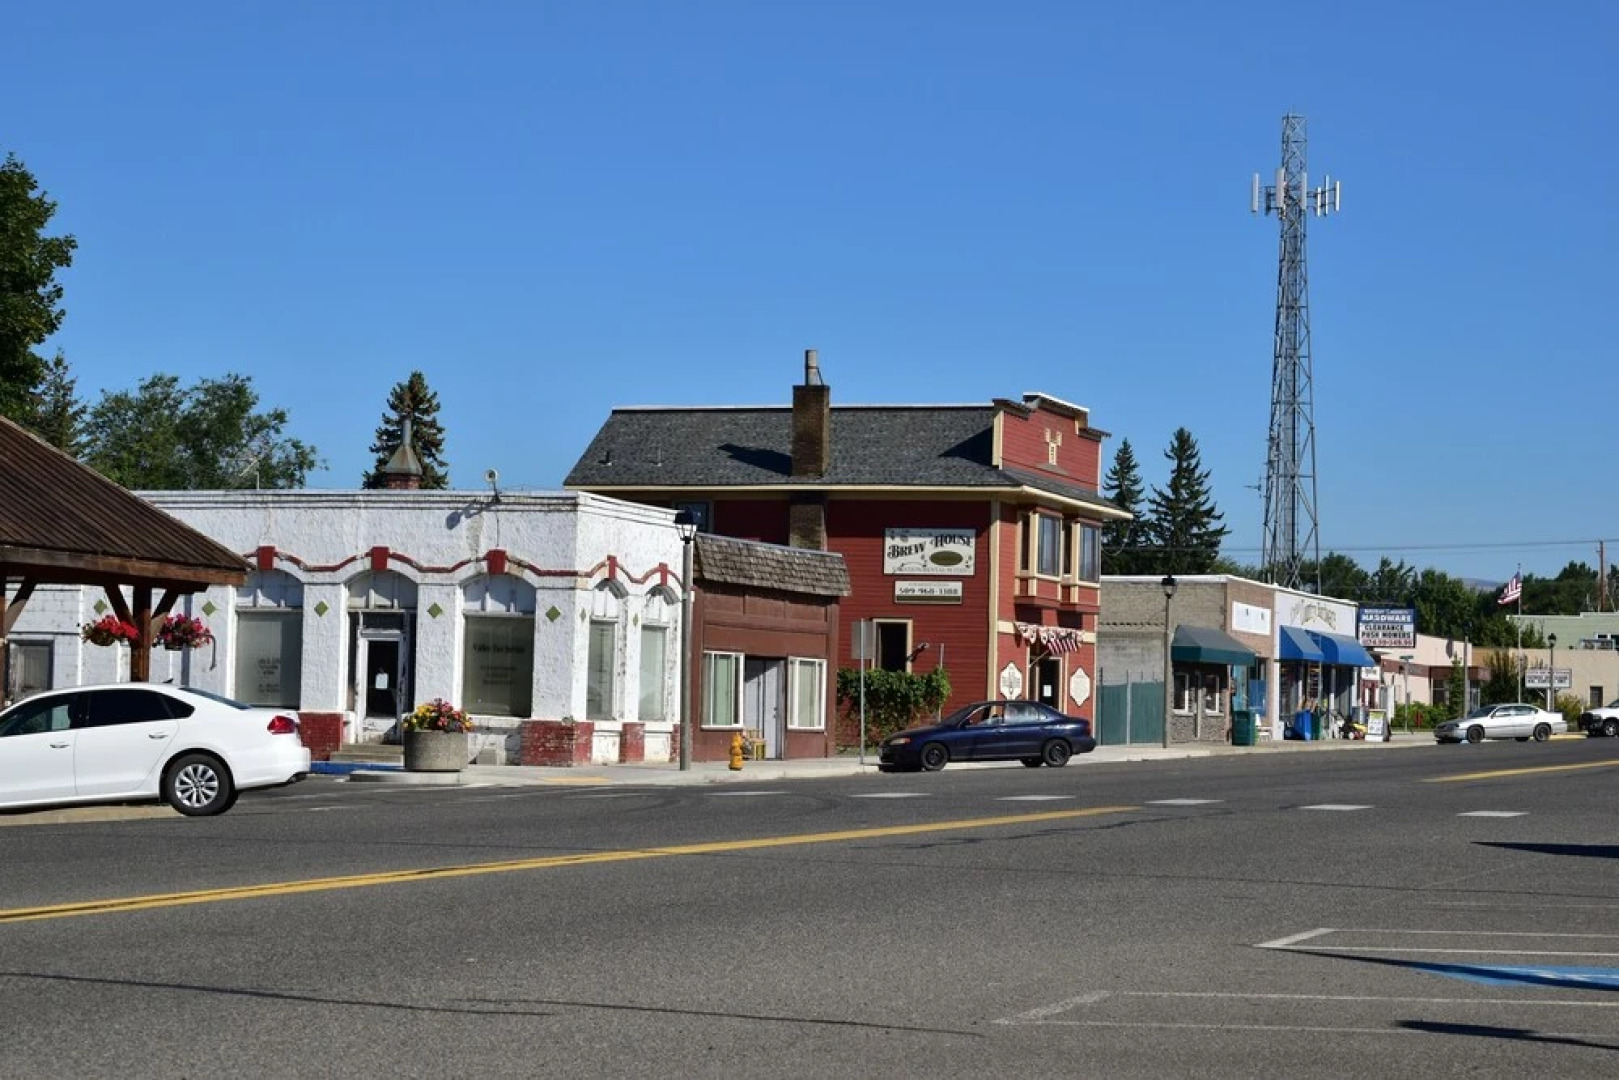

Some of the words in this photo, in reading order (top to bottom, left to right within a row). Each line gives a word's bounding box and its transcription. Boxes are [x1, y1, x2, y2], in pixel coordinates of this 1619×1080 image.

[887, 541, 926, 559] BREW
[930, 534, 972, 547] HOUSE
[1361, 614, 1411, 622] HARDWARE
